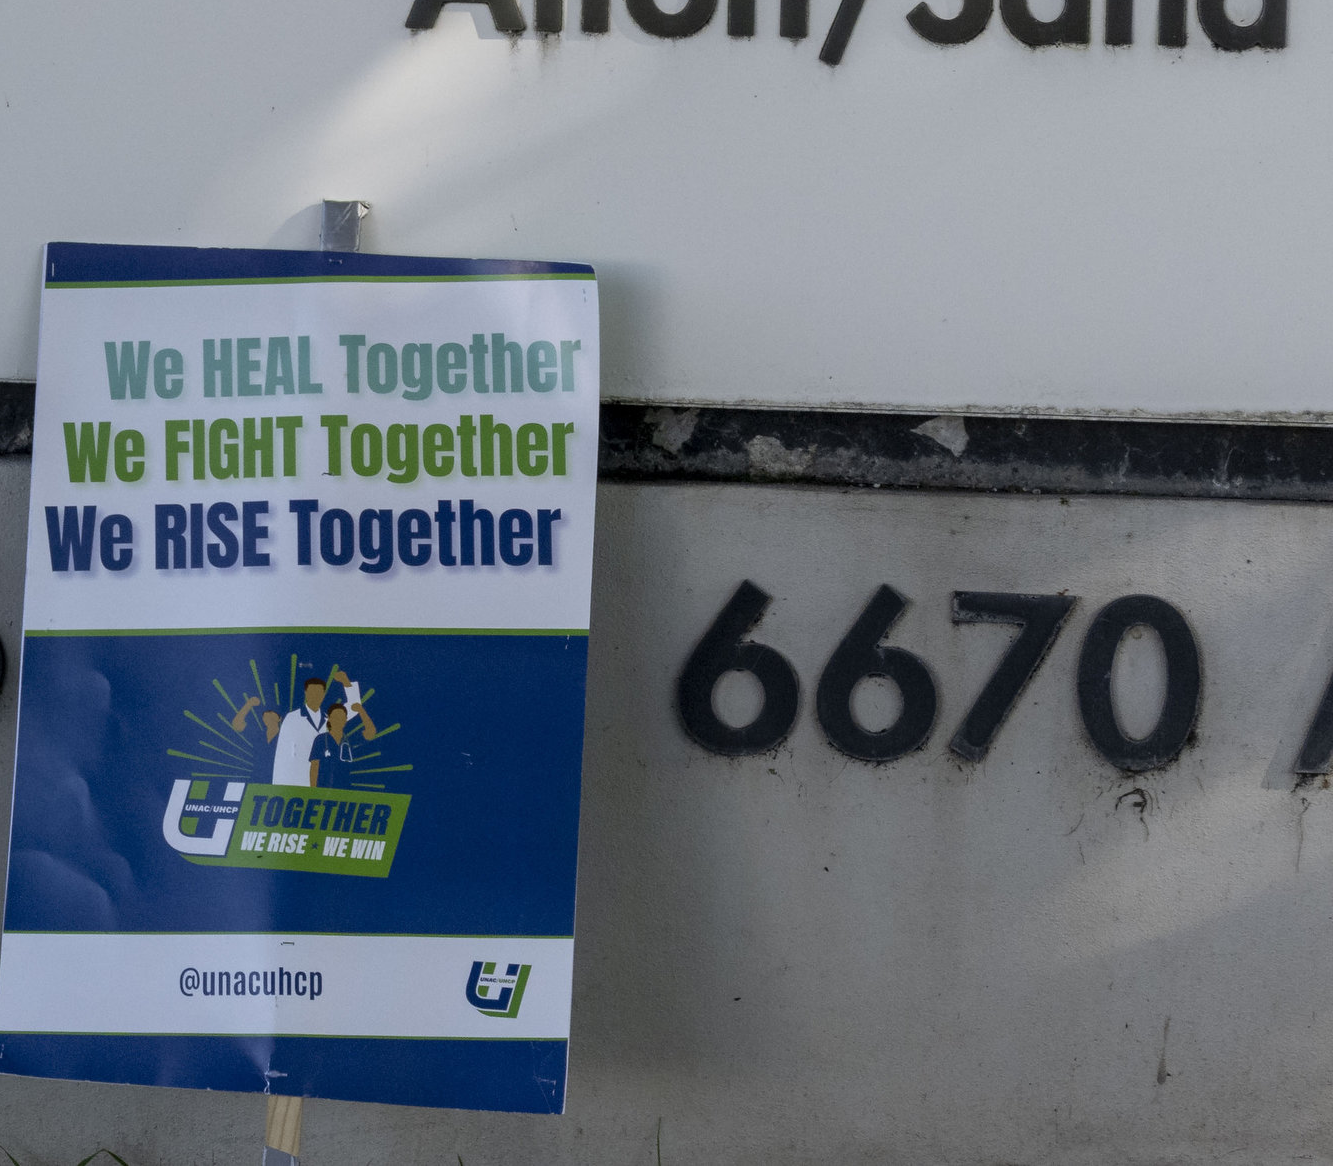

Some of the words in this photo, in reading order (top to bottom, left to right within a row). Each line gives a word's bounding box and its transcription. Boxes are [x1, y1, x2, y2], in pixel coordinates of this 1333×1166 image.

[103, 340, 184, 401] We
[202, 336, 323, 398] HEAL
[339, 333, 581, 401] Together
[62, 420, 146, 484] We
[164, 415, 304, 481] FIGHT
[321, 414, 575, 486] Together
[45, 504, 135, 572] We
[155, 500, 270, 571] RISE
[289, 499, 562, 575] Together
[676, 578, 1203, 773] 6670
[185, 804, 238, 814] UNAC/UHCP
[249, 795, 392, 835] TOGETHER
[240, 831, 267, 852] WE
[267, 832, 309, 854] RISE
[322, 836, 349, 858] WE
[350, 838, 386, 861] WIN
[179, 965, 323, 1001] @unacuhcp
